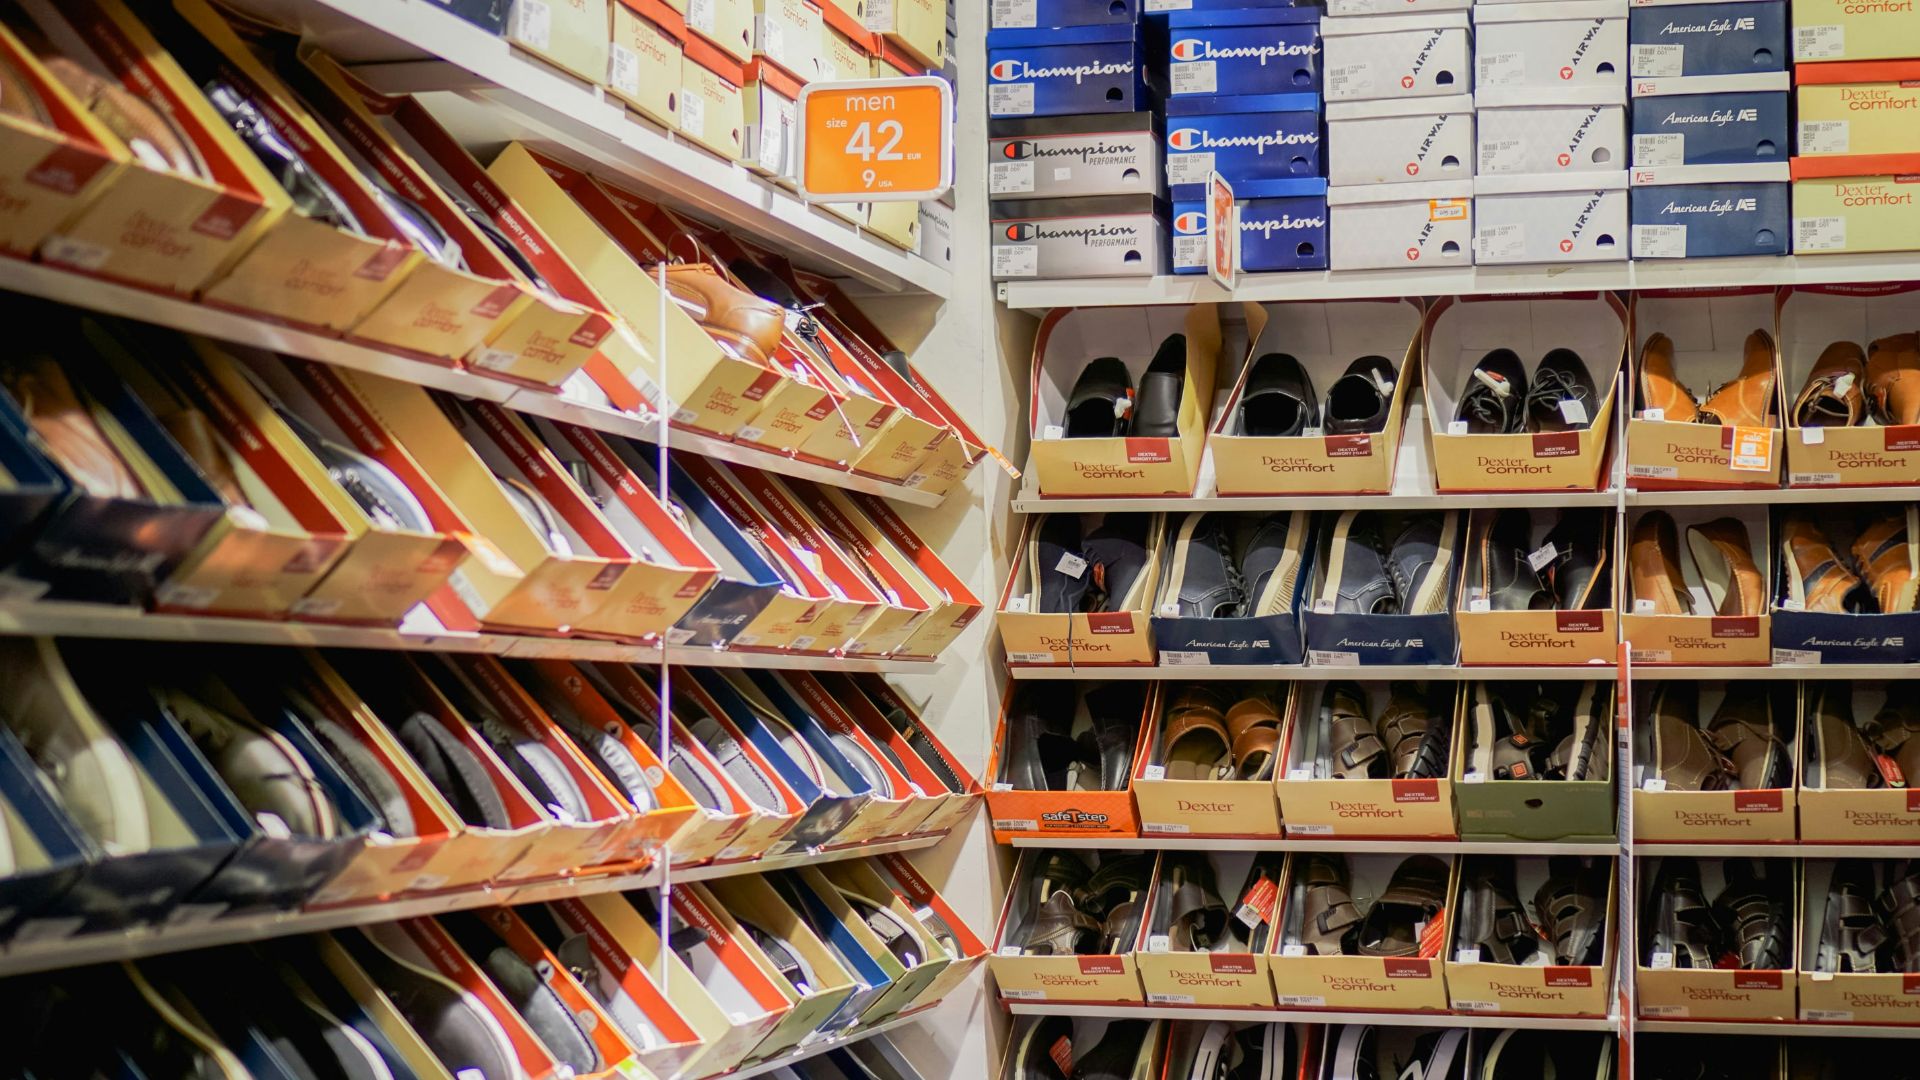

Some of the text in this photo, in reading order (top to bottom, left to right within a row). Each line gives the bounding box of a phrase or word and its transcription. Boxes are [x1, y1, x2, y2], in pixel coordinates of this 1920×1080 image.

[1844, 0, 1913, 14] comfort
[1660, 22, 1706, 35] American
[1708, 19, 1732, 35] Eagle
[1171, 39, 1320, 65] Champion
[990, 59, 1135, 84] Champion
[1840, 88, 1891, 101] Dexter
[846, 95, 895, 112] men
[1849, 97, 1918, 111] comfort
[1662, 112, 1709, 125] American
[1710, 109, 1734, 127] Eagle
[826, 118, 848, 128] size
[845, 119, 904, 162] 42
[1168, 128, 1319, 154] Champion
[1003, 141, 1136, 163] Champion
[1089, 156, 1136, 165] PERFORMANCE
[862, 169, 876, 188] 9
[1835, 184, 1886, 197] Dexter
[1843, 193, 1912, 206] comfort
[1661, 202, 1707, 214] American
[1709, 199, 1733, 216] Eagle
[1174, 212, 1325, 239] Cmpion
[1005, 223, 1137, 245] Champion
[1091, 237, 1137, 247] PERFORMANCE
[821, 317, 842, 337] DEXTER
[841, 334, 864, 359] MEMORY
[571, 426, 594, 452] DEXTER
[593, 450, 620, 477] MEMORY
[1666, 443, 1716, 456] Dexter
[1829, 450, 1880, 460] Dexter
[1262, 456, 1309, 466] Dexter
[1478, 457, 1525, 467] Dexter
[1674, 454, 1731, 466] comfo
[1837, 458, 1906, 468] comfort
[1074, 461, 1119, 472] Dexter
[1271, 464, 1335, 473] comfort
[1486, 464, 1552, 474] comfort
[1083, 469, 1144, 479] comfort
[707, 477, 769, 540] DEXTER MEMORY FOAM
[763, 488, 821, 549] DEXTER MEMORY FOAM
[817, 500, 873, 557] DEXTER MEMORY FOAM
[1040, 636, 1085, 645] Dexter
[1501, 631, 1549, 641] Dexter
[1669, 635, 1706, 644] Dexter
[1049, 643, 1111, 652] comfort
[1186, 639, 1227, 648] American
[1228, 640, 1249, 650] Eagle
[1336, 638, 1378, 647] American
[1380, 639, 1402, 650] Eagle
[1509, 639, 1575, 648] comfort
[1674, 641, 1727, 649] comfort
[1802, 636, 1852, 646] American
[1853, 638, 1878, 649] Eagle
[1177, 800, 1234, 812] Dexter
[1329, 801, 1377, 811] Dexter
[1338, 809, 1404, 818] comfort
[1675, 810, 1724, 819] Dexter
[1845, 810, 1896, 819] Dexter
[1683, 818, 1751, 826] comfort
[684, 899, 727, 946] MEMORY FOAM
[1034, 973, 1073, 981] Dexter
[1170, 970, 1214, 979] Dexter
[1322, 975, 1369, 984] Dexter
[1179, 978, 1242, 987] comfort
[1331, 983, 1397, 991] comfort
[1490, 981, 1538, 992] Dexter
[1498, 991, 1564, 1000] comfort
[1682, 986, 1726, 995] Dexter
[1843, 991, 1894, 1000] Dexter
[1690, 993, 1750, 1001] comfort
